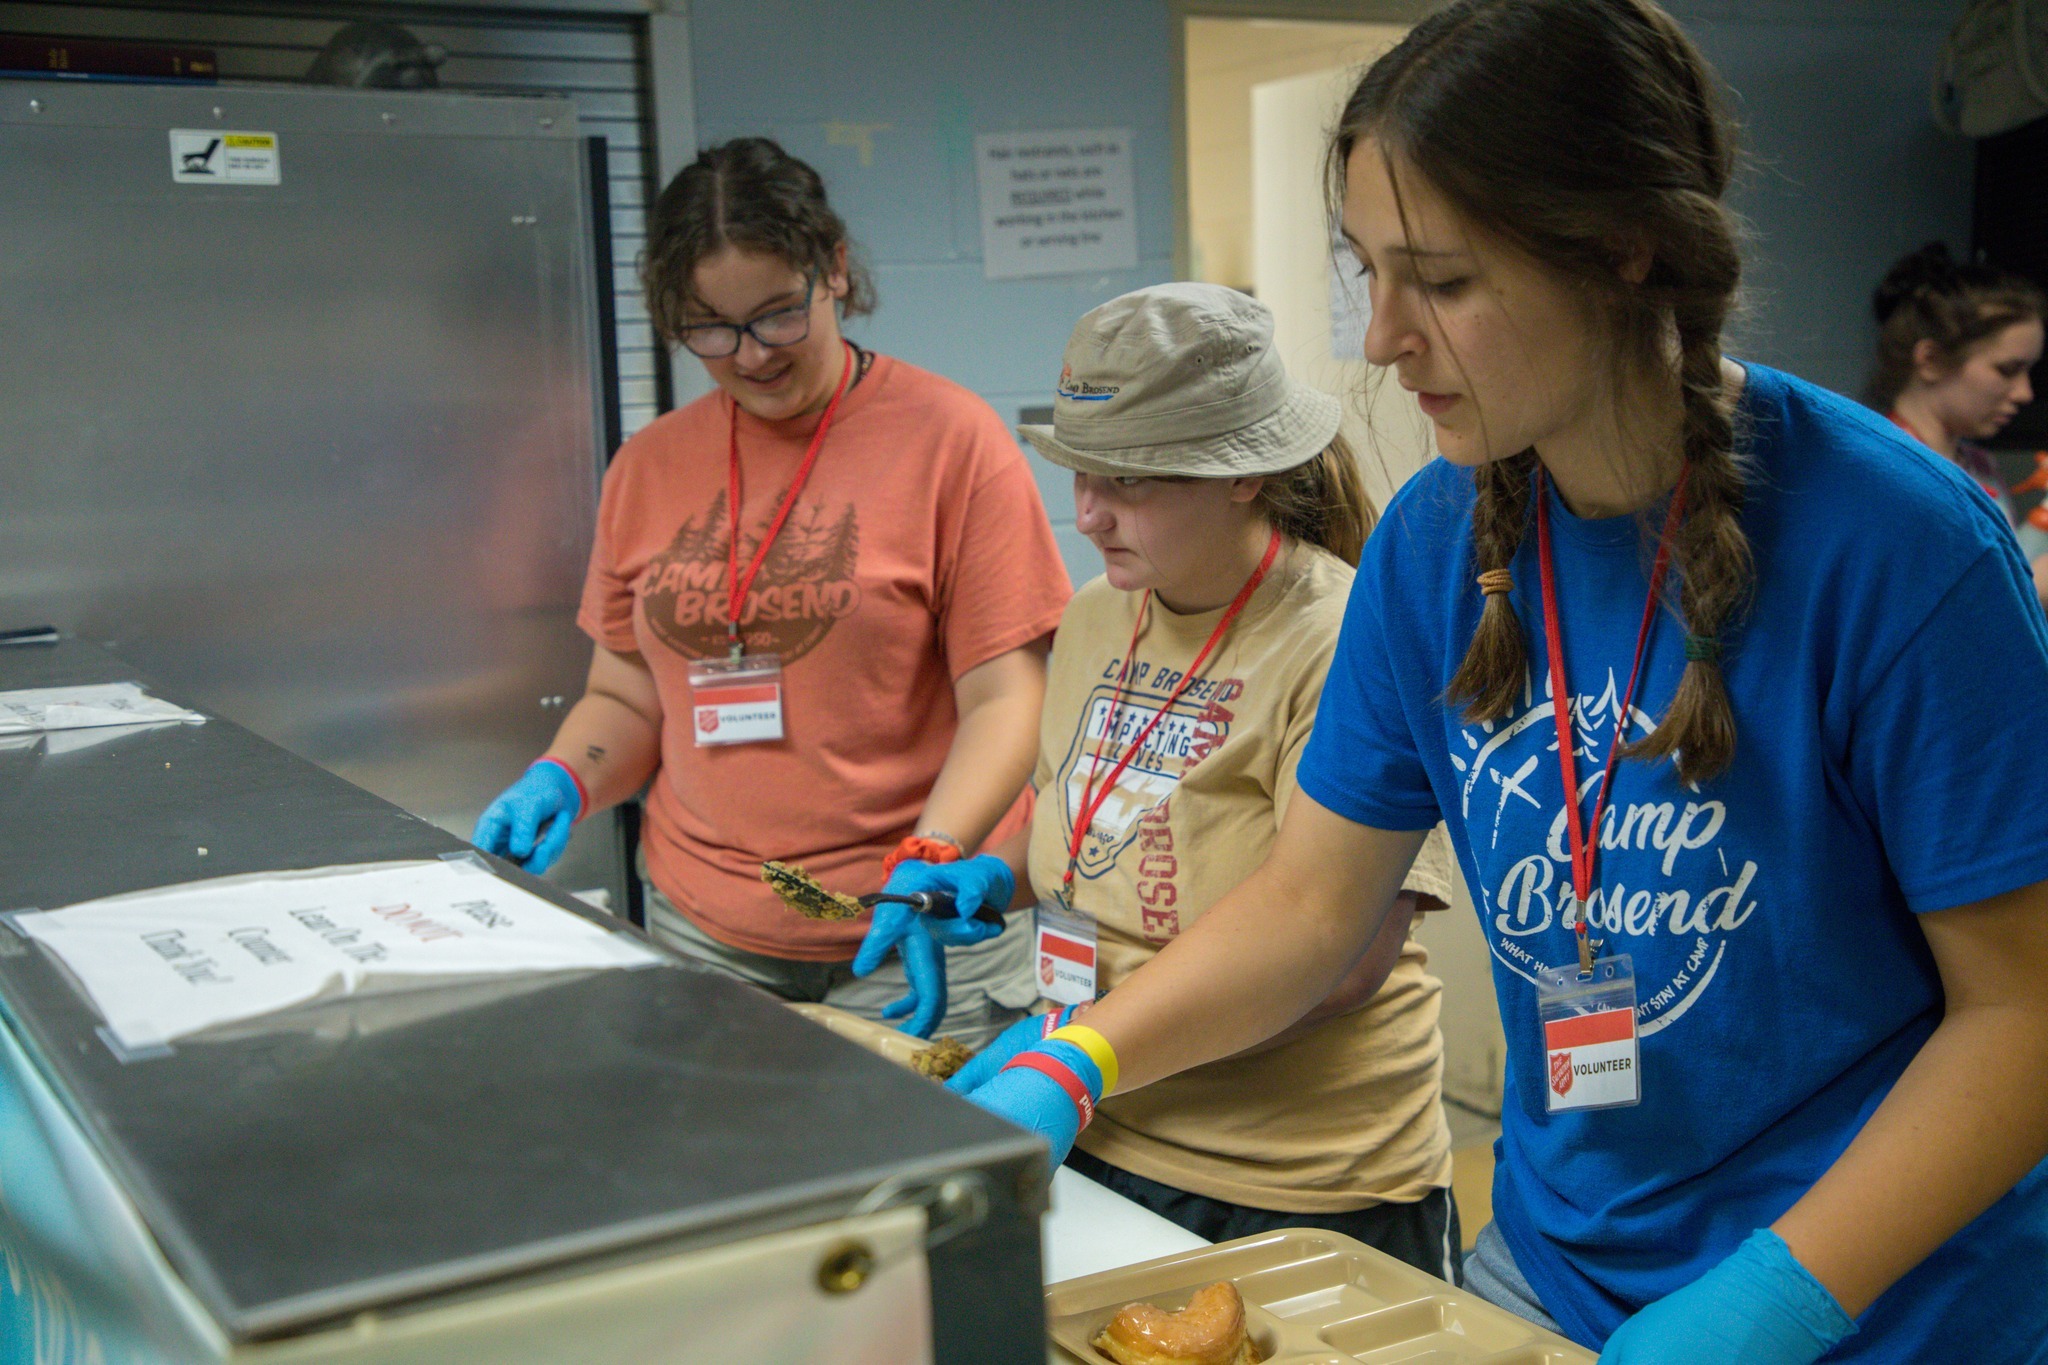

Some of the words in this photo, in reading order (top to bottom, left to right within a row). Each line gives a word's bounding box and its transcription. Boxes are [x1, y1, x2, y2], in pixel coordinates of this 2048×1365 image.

[1102, 658, 1151, 685] CAMP
[1097, 717, 1191, 757] IMPACTING
[1113, 742, 1164, 771] LVES
[1546, 770, 1727, 877] Camp
[1496, 855, 1758, 937] Brosend
[1055, 970, 1092, 988] VOLUNTEER
[1500, 937, 1534, 965] WHAT
[1651, 985, 1676, 1010] STAY
[1672, 970, 1691, 991] AT
[1686, 936, 1709, 973] CAMP
[1574, 1057, 1632, 1076] VOLUNTEER
